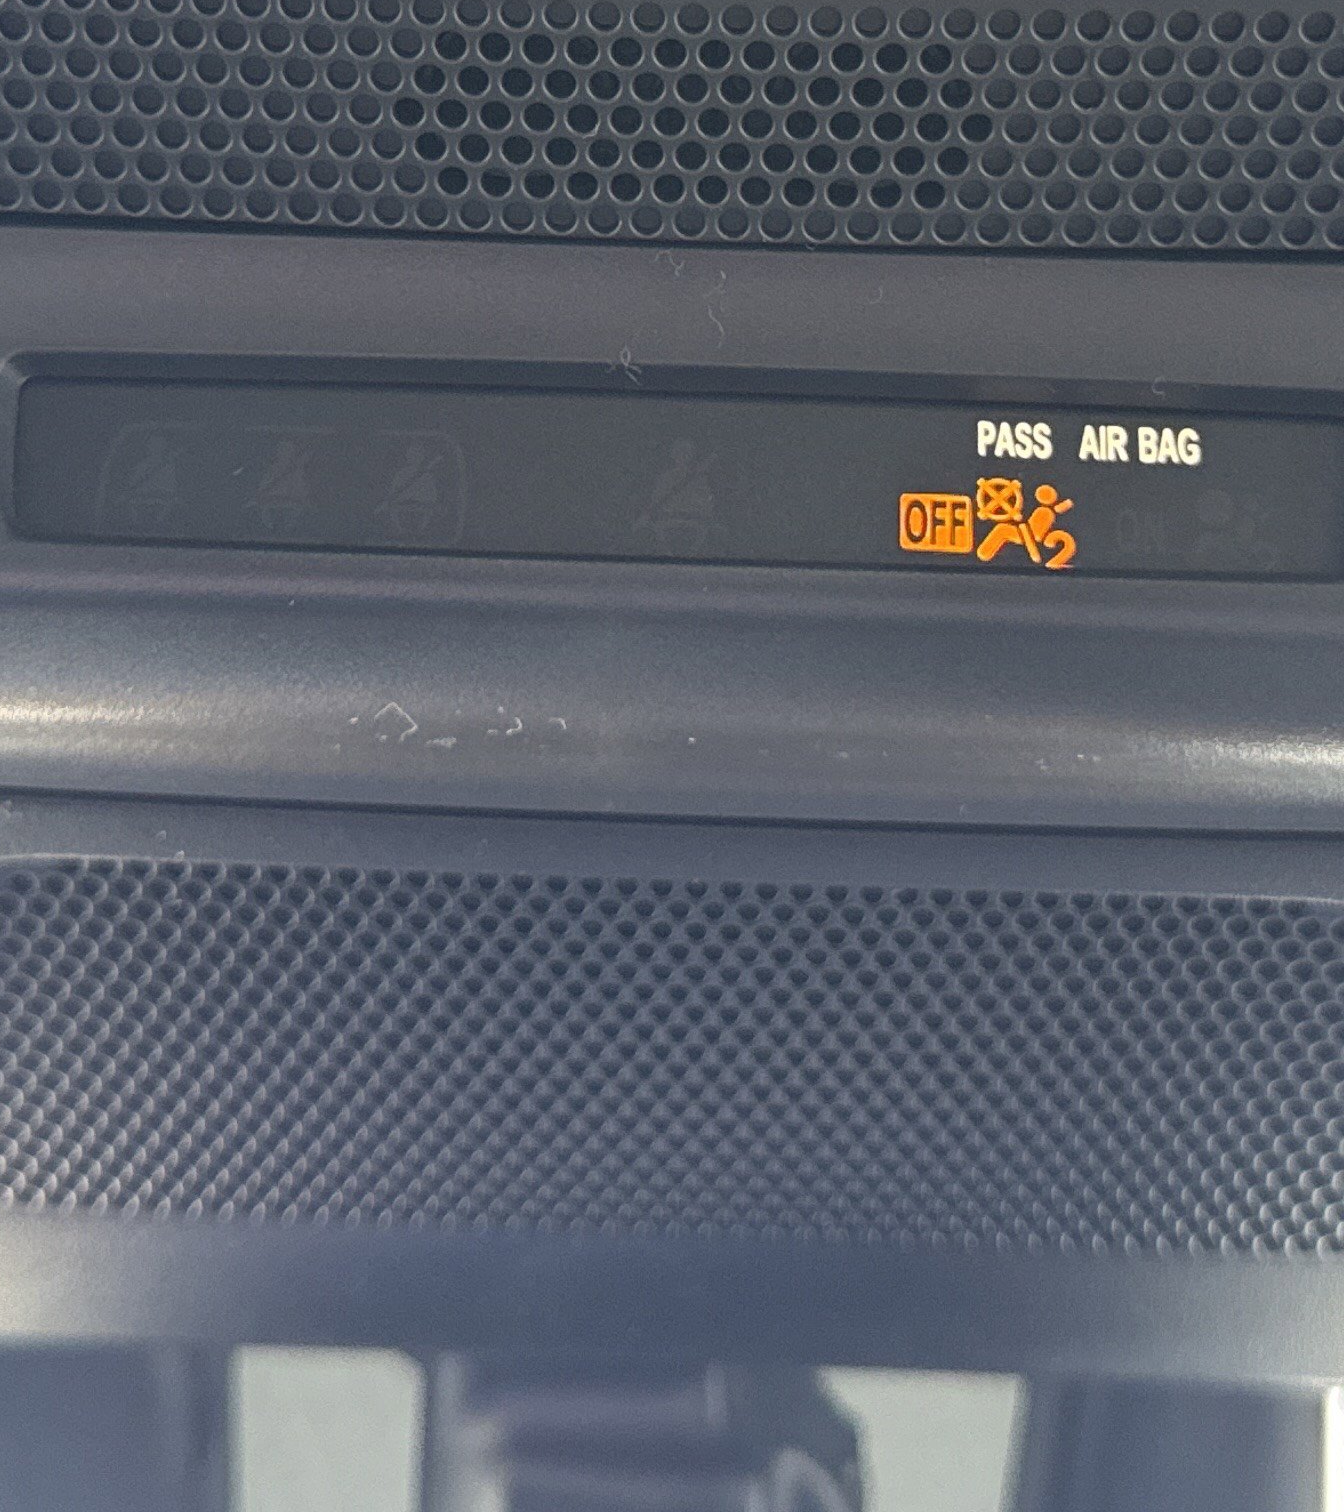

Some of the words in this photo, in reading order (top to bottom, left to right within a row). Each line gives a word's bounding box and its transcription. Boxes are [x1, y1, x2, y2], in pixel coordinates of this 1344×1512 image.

[977, 420, 1052, 460] PASS
[1079, 425, 1129, 462] AIR
[1138, 428, 1202, 467] BAG
[906, 500, 967, 546] OFF
